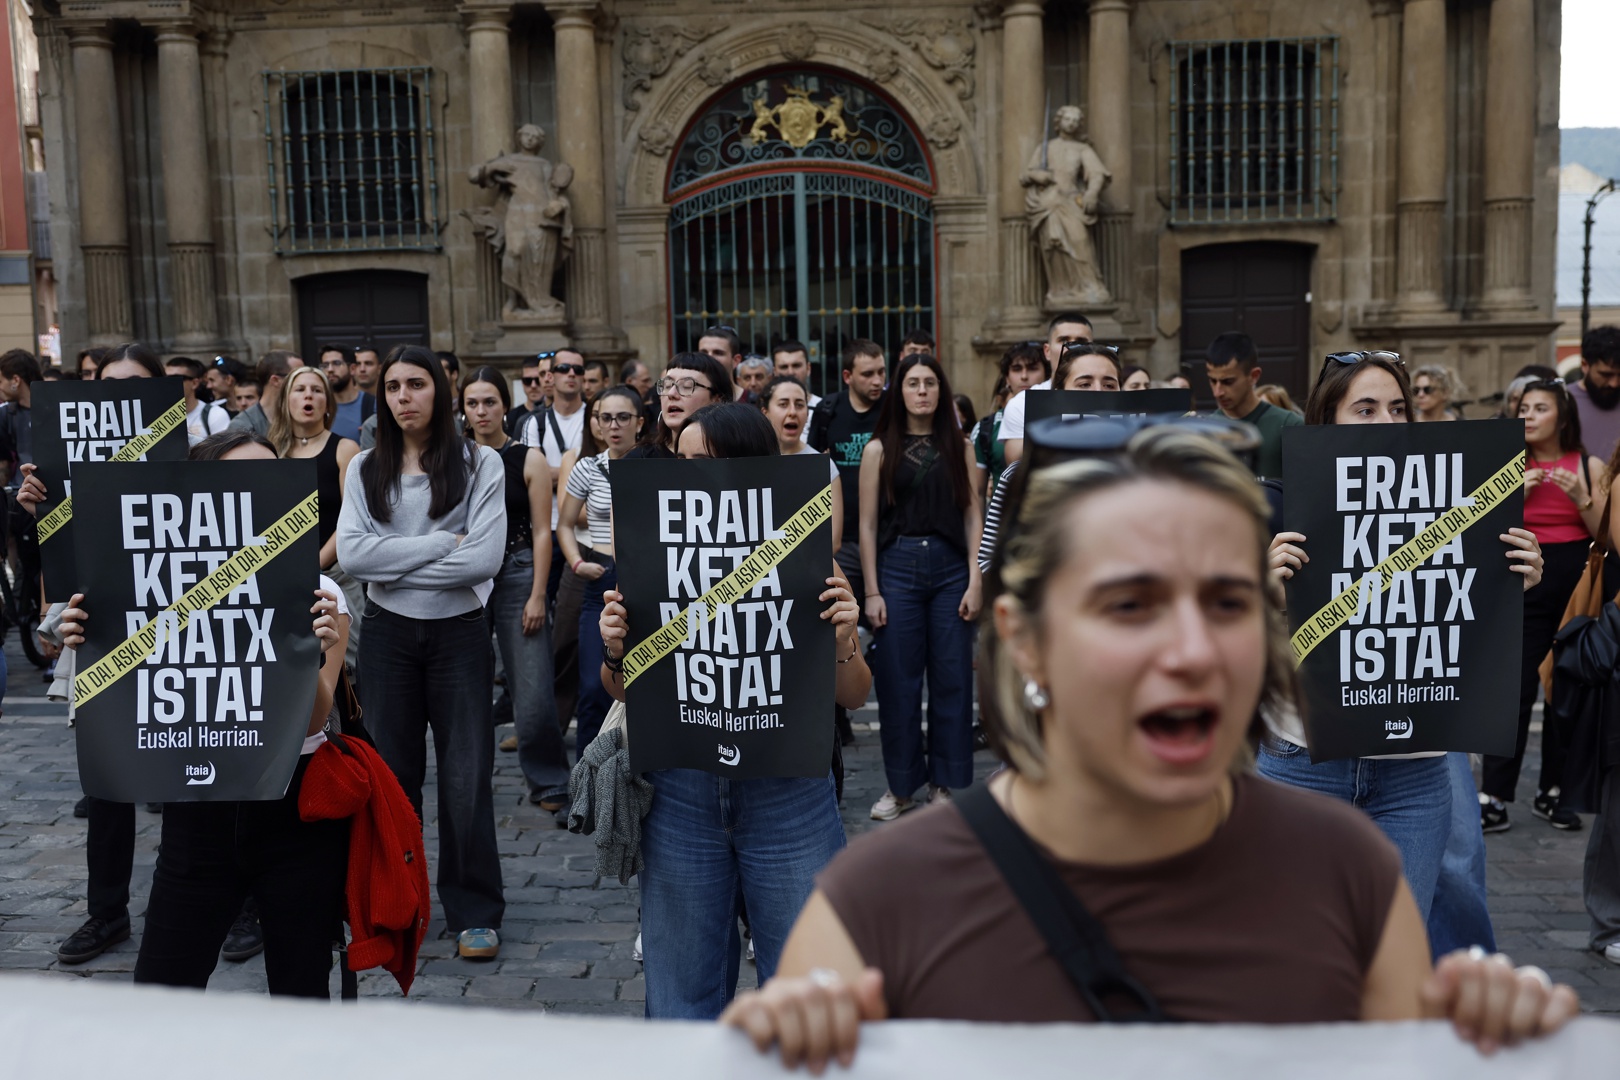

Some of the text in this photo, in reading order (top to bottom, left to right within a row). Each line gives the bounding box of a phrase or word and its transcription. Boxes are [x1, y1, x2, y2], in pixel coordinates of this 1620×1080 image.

[59, 399, 152, 439] ERAIL
[132, 436, 149, 452] DA!
[164, 409, 182, 426] DA!
[835, 441, 864, 452] NORT
[1336, 453, 1476, 511] ERAIL
[45, 513, 62, 529] DA!
[120, 492, 267, 549] ERAIL
[658, 487, 787, 543] ERAIL
[1342, 512, 1465, 568] KETA
[132, 551, 262, 607] KETA
[632, 645, 656, 667] DA!
[650, 629, 678, 654] ASKI
[715, 581, 738, 604] DA!
[734, 558, 763, 588] ASKI
[758, 541, 782, 565] DA!
[780, 519, 805, 549] ASKI
[801, 502, 825, 526] DA!
[666, 545, 782, 599] KETA
[1297, 625, 1319, 649] DA!
[1316, 603, 1346, 633] ASKI
[1392, 547, 1418, 571] DA!
[1415, 525, 1446, 555] ASKI
[1443, 508, 1469, 533] DA!
[1468, 486, 1497, 517] ASKI
[1493, 469, 1518, 494] DA!
[87, 663, 115, 687] DA!
[111, 641, 143, 671] ASKI
[187, 586, 213, 610] DA!
[209, 564, 240, 594] ASKI
[236, 547, 262, 572] DA!
[260, 526, 289, 556] ASKI
[285, 509, 311, 534] DA!
[1331, 568, 1477, 625] MATX
[125, 608, 277, 664] MATX
[659, 599, 794, 655] MATX
[1339, 625, 1460, 682] ISTA!
[136, 666, 264, 724] ISTA!
[674, 652, 783, 709] ISTA!
[1341, 682, 1460, 706] Euskal Herrian.
[138, 725, 264, 749] Euskal Herrian.
[680, 704, 785, 732] Euskal Herrian.
[1385, 720, 1407, 730] itaia
[185, 764, 209, 777] itaia
[717, 743, 735, 758] itaia
